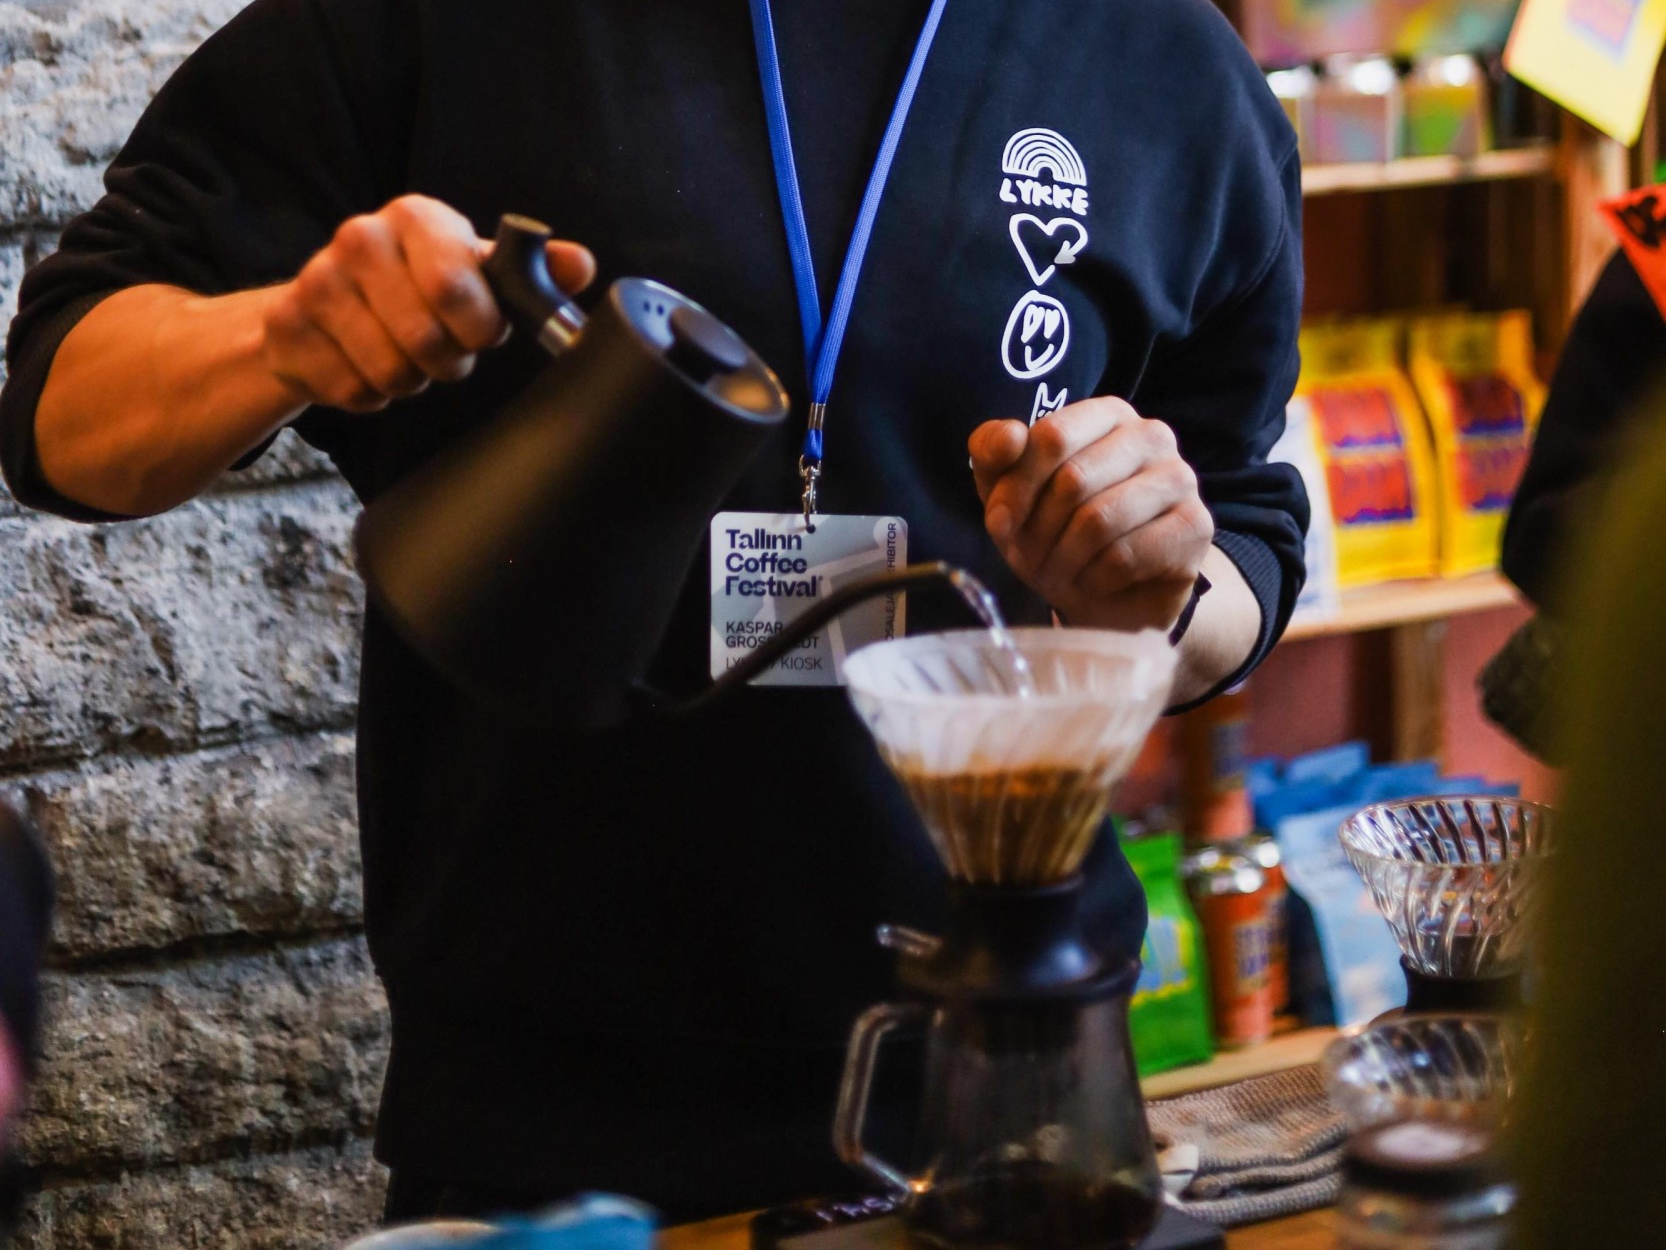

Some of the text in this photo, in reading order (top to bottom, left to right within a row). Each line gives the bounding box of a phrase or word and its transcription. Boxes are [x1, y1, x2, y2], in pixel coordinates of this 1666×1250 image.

[999, 178, 1089, 216] LYKKE
[725, 528, 802, 550] Tallinn
[887, 523, 896, 574] HIBITOR
[725, 552, 807, 574] Coffee
[725, 575, 818, 597] Festival
[726, 621, 784, 634] KASPAR
[781, 657, 823, 670] KIOSK
